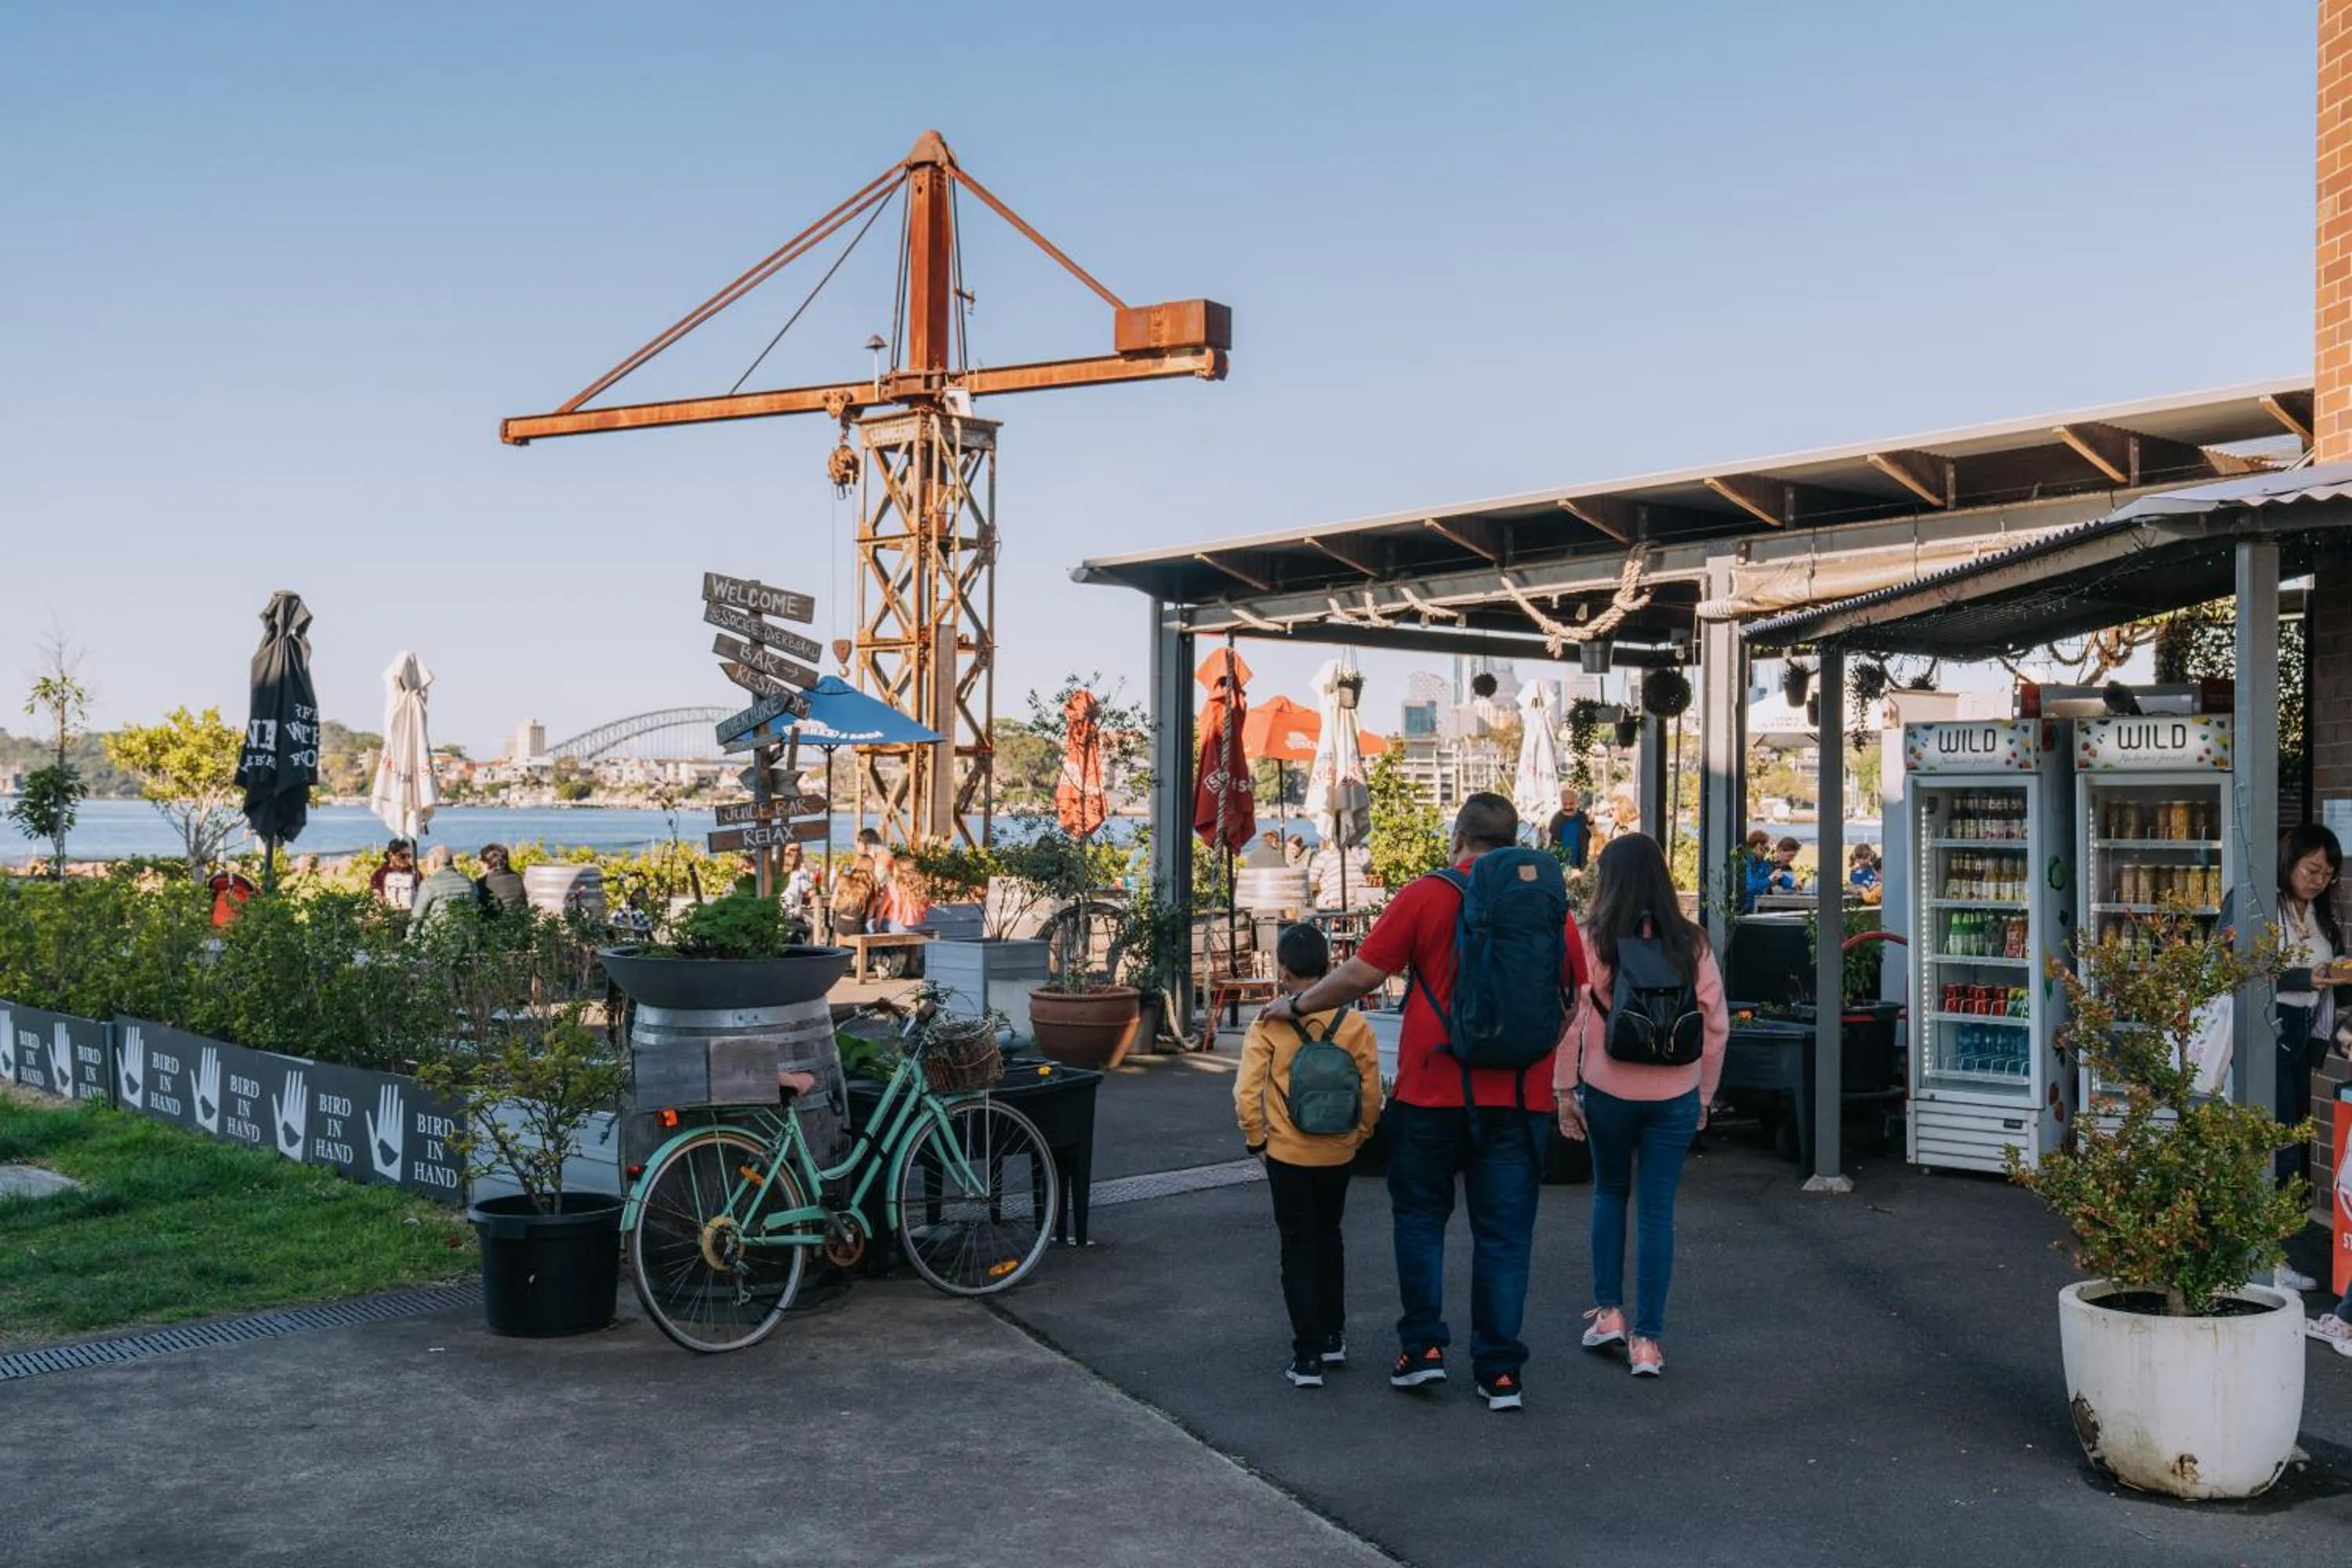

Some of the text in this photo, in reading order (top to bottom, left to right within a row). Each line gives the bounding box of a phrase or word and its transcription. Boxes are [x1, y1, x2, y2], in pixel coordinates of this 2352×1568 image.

[712, 575, 800, 615] WELCOME
[739, 644, 779, 673] BAR
[1938, 728, 1997, 753] WILD
[2118, 724, 2187, 750] WILD
[724, 797, 811, 821] JUICE BAR
[742, 824, 796, 847] RELAX
[18, 1029, 40, 1050] BIRD
[25, 1050, 36, 1066] IN
[77, 1044, 101, 1065] BIRD
[152, 1051, 180, 1075] BIRD
[20, 1066, 45, 1087] HAND
[85, 1065, 96, 1082] IN
[159, 1074, 172, 1093] IN
[230, 1074, 260, 1098] BIRD
[150, 1091, 181, 1116] HAND
[238, 1098, 251, 1117] IN
[319, 1094, 352, 1117] BIRD
[226, 1116, 260, 1142] HAND
[328, 1118, 343, 1138] IN
[416, 1112, 455, 1138] BIRD
[316, 1138, 354, 1164] HAND
[426, 1139, 445, 1162] IN
[413, 1160, 458, 1189] HAND
